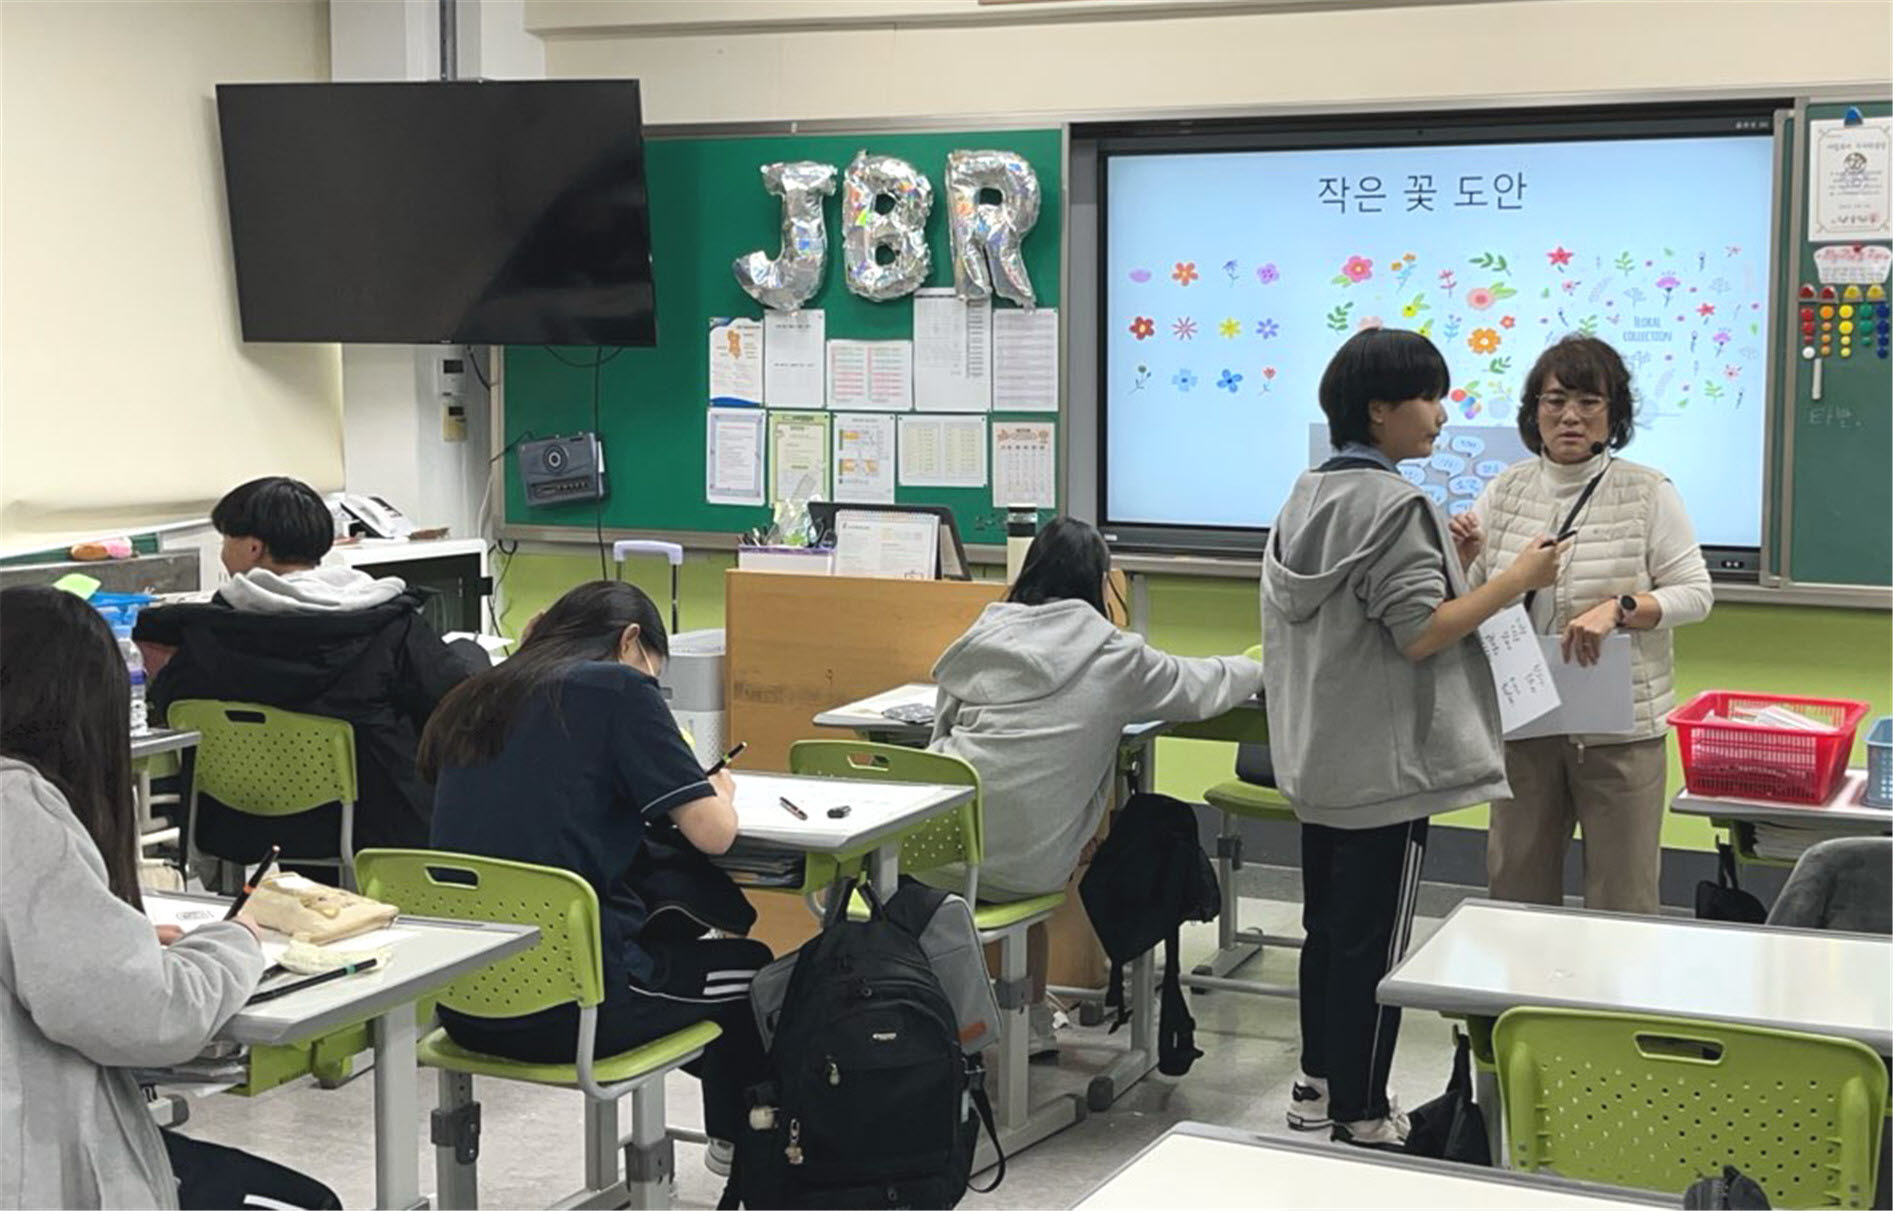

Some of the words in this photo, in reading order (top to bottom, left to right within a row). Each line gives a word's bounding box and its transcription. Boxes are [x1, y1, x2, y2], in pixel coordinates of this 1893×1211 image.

[732, 150, 1041, 314] JBR
[1318, 176, 1387, 214] 작은
[1404, 174, 1438, 212] 꽃
[1454, 171, 1528, 210] 도안
